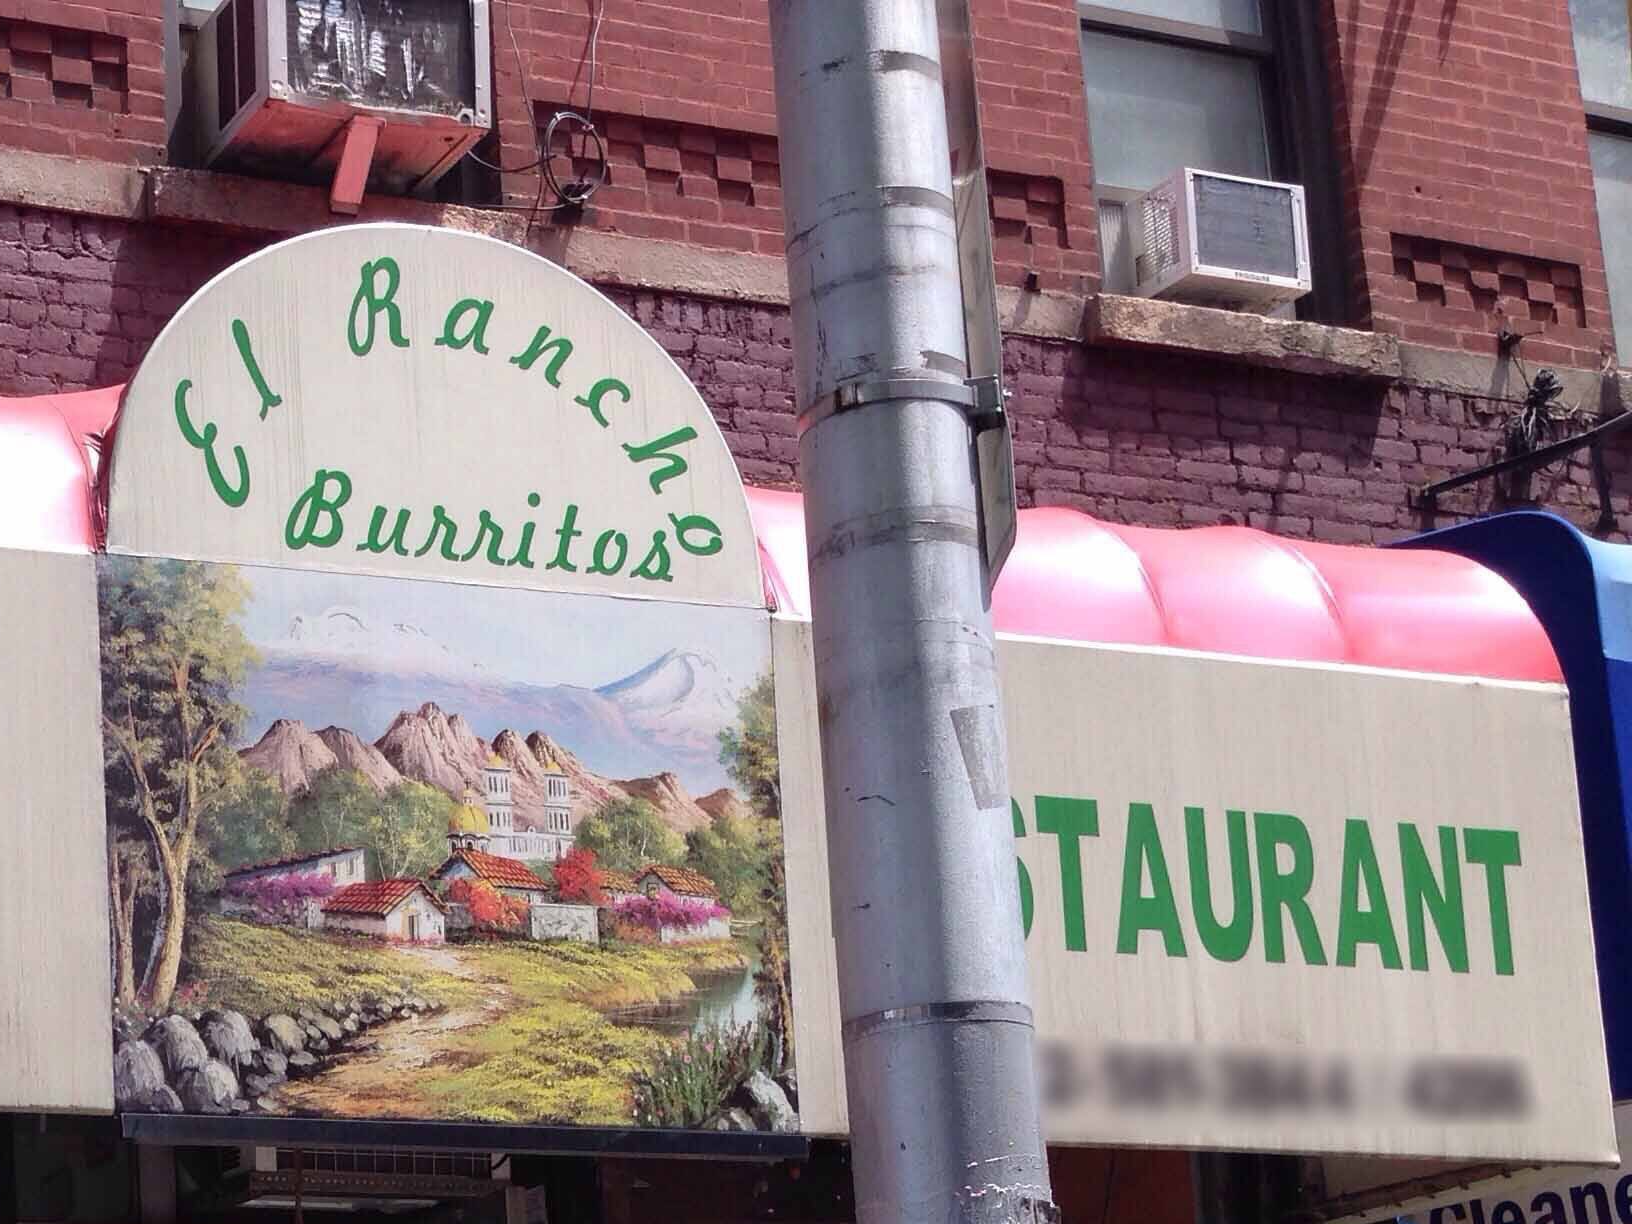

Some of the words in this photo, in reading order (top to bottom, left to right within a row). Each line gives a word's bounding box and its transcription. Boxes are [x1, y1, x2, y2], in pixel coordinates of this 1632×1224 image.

[174, 318, 282, 507] El
[347, 255, 722, 557] Rancho
[285, 468, 673, 583] Burritos
[1011, 794, 1522, 977] TAURANT
